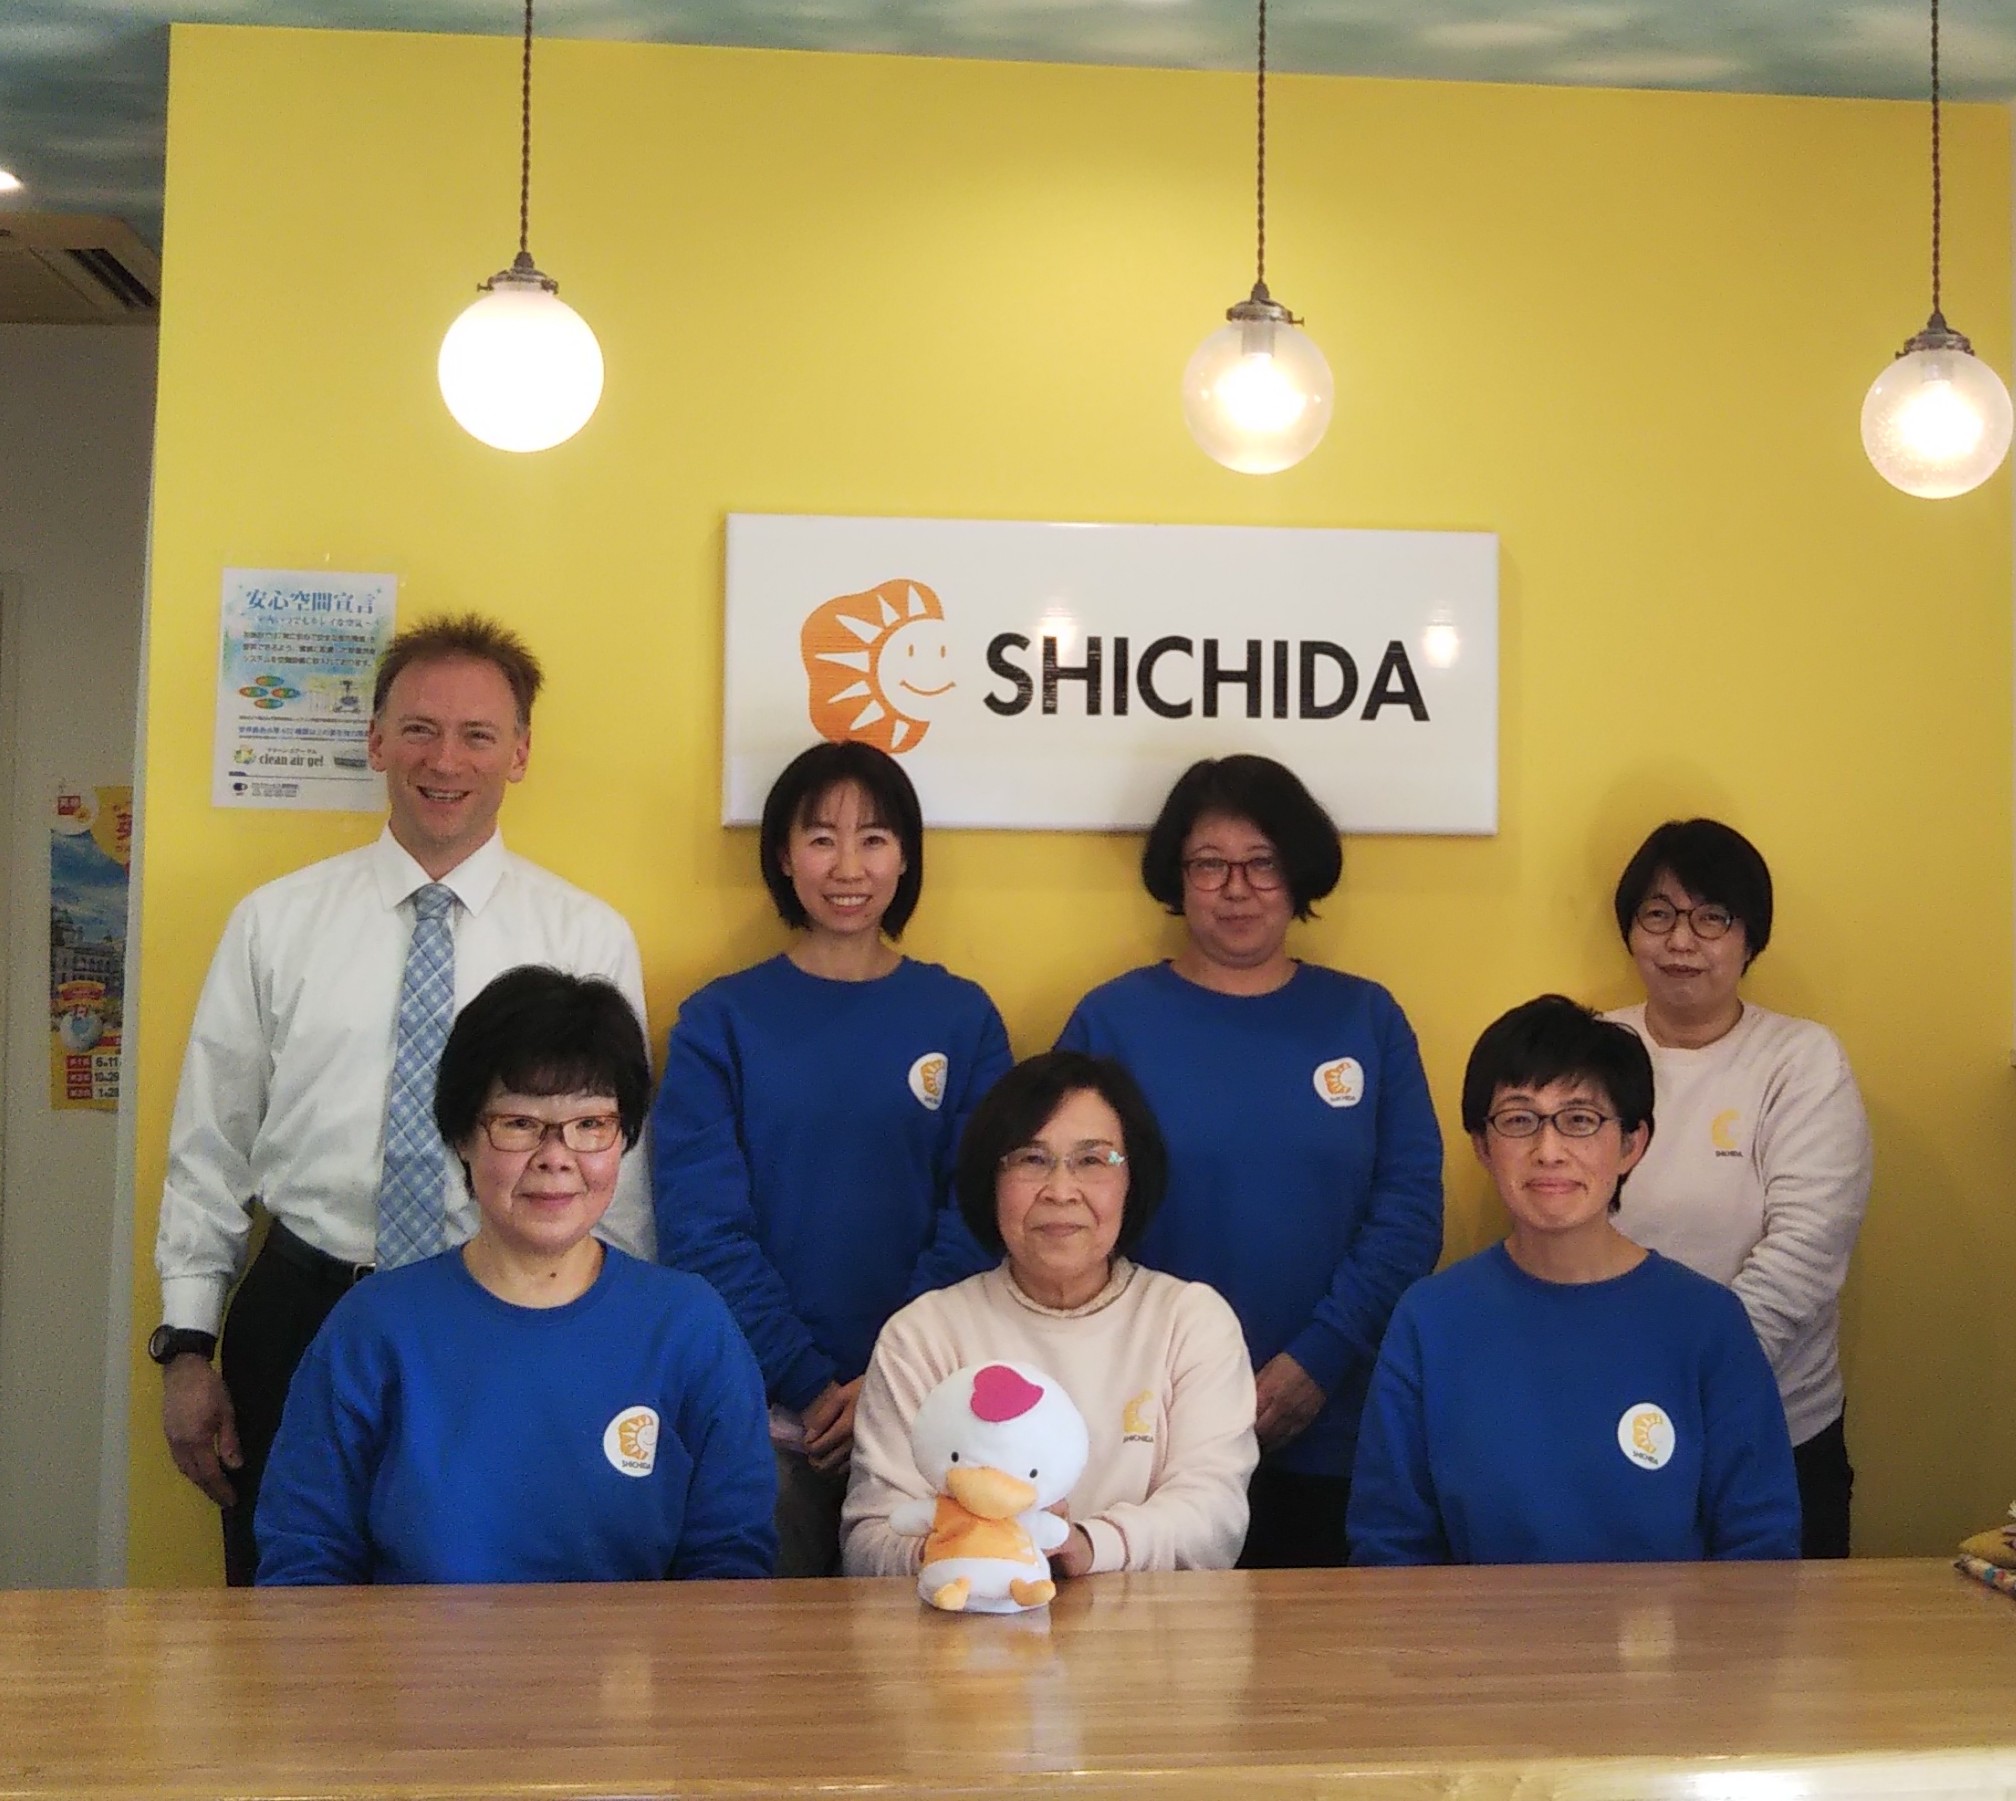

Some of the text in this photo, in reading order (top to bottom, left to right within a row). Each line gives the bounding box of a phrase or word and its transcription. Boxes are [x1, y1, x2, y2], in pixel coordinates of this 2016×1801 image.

[246, 588, 376, 614] 安心空間宣言
[983, 632, 1431, 722] SHICHIDA
[259, 753, 324, 768] clean air gel
[621, 1459, 651, 1470] SHICHIDA
